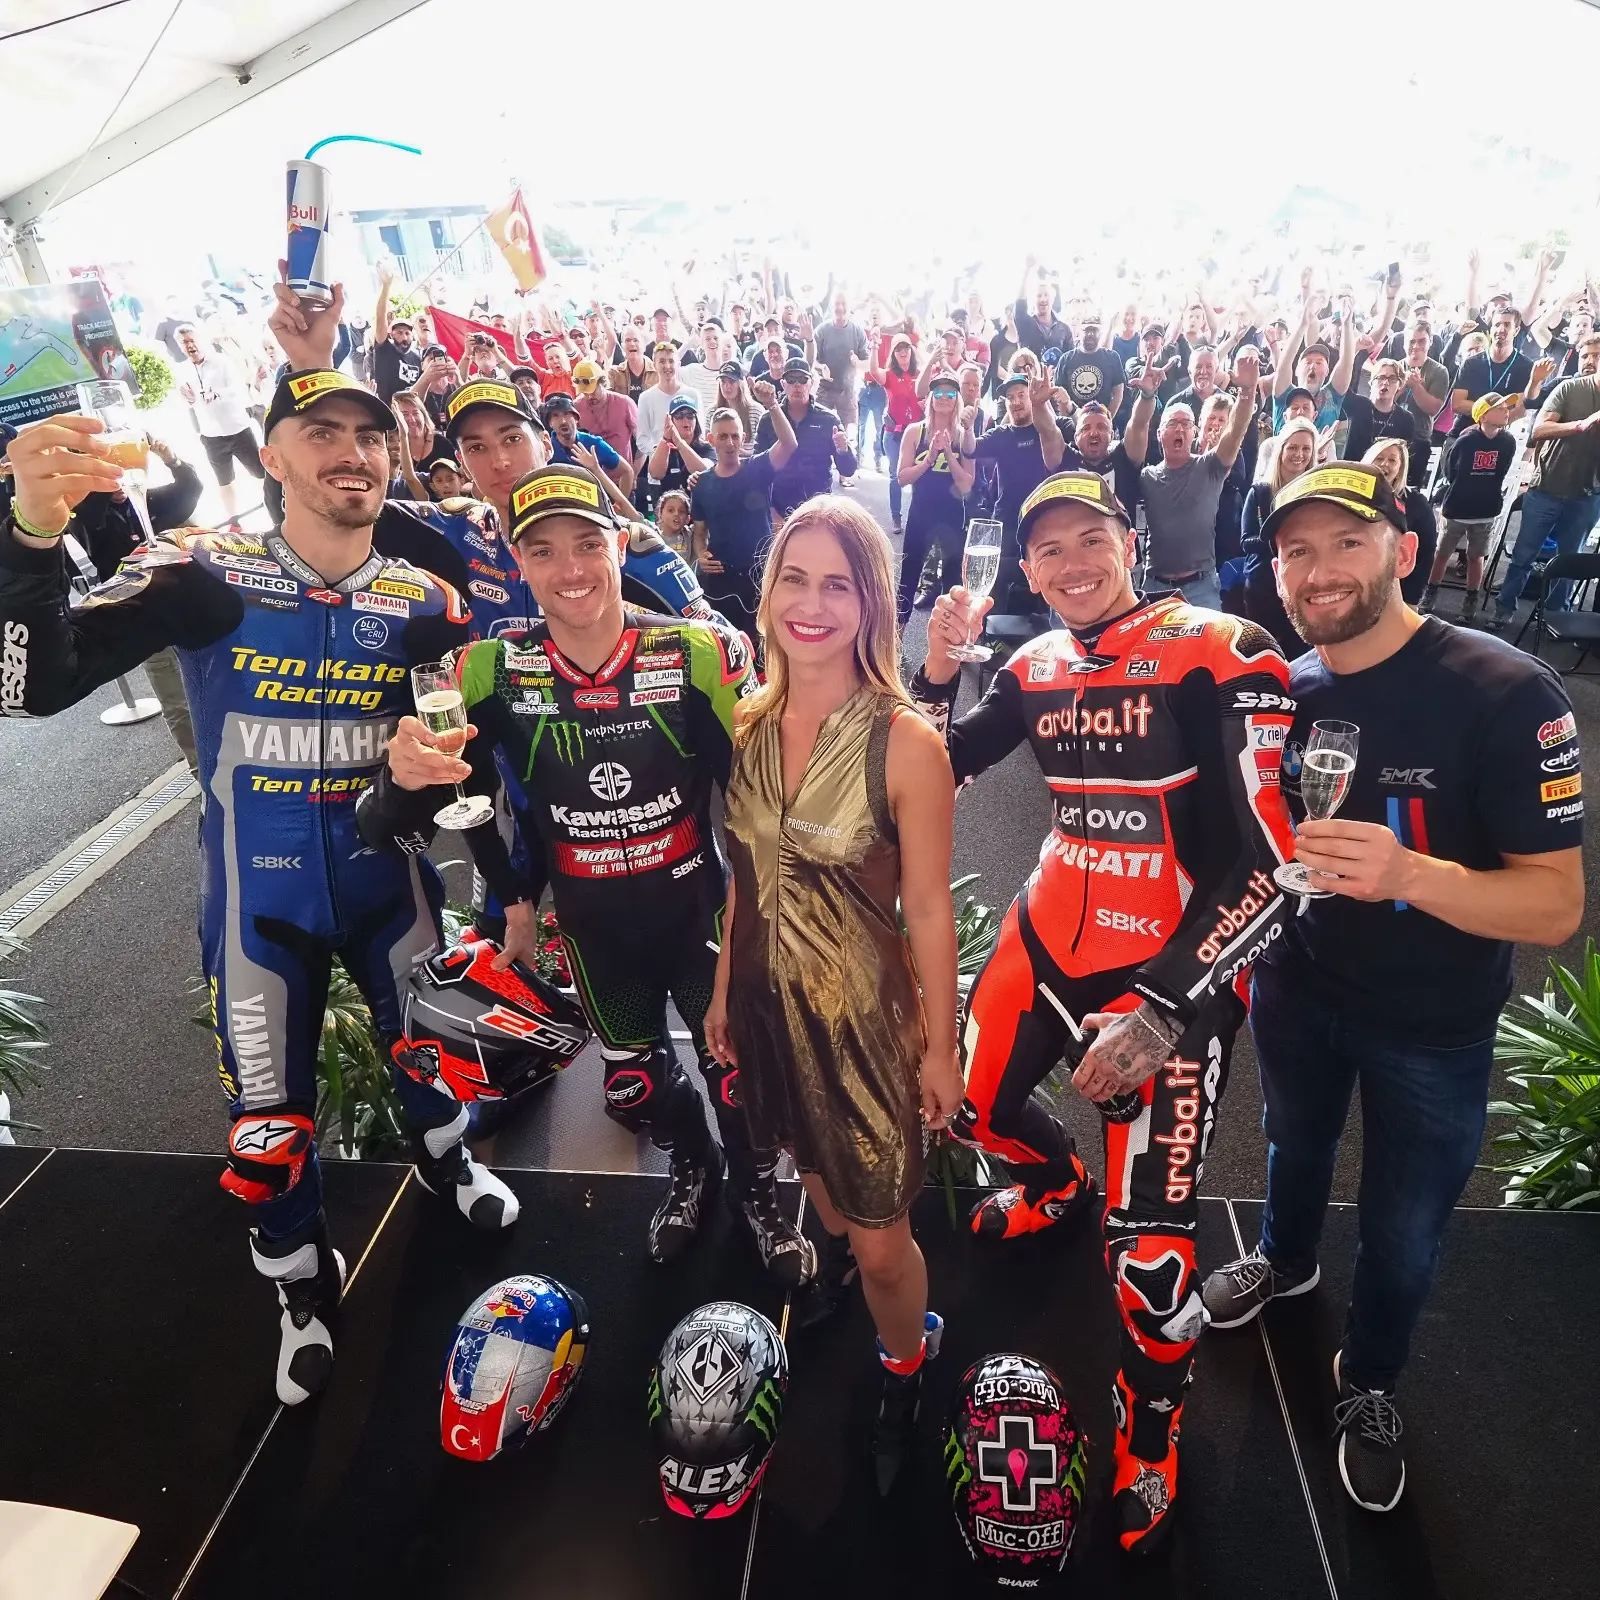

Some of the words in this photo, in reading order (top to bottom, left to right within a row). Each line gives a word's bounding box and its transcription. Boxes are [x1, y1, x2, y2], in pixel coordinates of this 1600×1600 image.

[288, 204, 318, 222] Bull
[77, 322, 95, 331] TRACK
[84, 330, 113, 340] PROHIBITED
[0, 402, 20, 414] ccess
[20, 399, 29, 408] to
[29, 397, 41, 406] the
[41, 392, 58, 403] track
[59, 390, 66, 399] is
[451, 385, 512, 414] PIRELLI
[518, 480, 593, 507] PIRELLI
[241, 574, 296, 592] ENEOS
[346, 565, 378, 590] YAMAHA
[475, 584, 504, 600] SHOEI
[260, 597, 300, 608] DELCOURT
[367, 595, 408, 611] YAMAHA
[231, 647, 307, 675] Ten
[316, 659, 406, 683] Kate
[507, 654, 549, 666] Swinton
[1128, 660, 1157, 672] FAI
[254, 680, 383, 711] Racing
[633, 689, 677, 704] SHOWA
[513, 703, 559, 713] SHARK
[1037, 694, 1153, 738] aruba.it
[585, 720, 652, 738] MONSTER
[596, 732, 644, 744] ENERGY
[238, 720, 389, 763] YAMAHA
[251, 775, 303, 793] Ten
[550, 786, 682, 827] Kawasaki
[568, 826, 628, 840] Racing
[628, 815, 672, 834] Team
[787, 817, 823, 835] PROSECCO
[824, 827, 842, 839] DOC
[252, 856, 299, 869] SBK
[591, 863, 609, 875] FUEL
[611, 861, 633, 873] YOUR
[634, 852, 664, 870] PASSION
[1096, 908, 1158, 938] SBK
[1196, 870, 1276, 964] aruba.it
[607, 1081, 644, 1100] RST
[1155, 1054, 1200, 1203] aruba.it
[660, 1454, 750, 1494] ALEX
[979, 1521, 1061, 1546] Muc-Off
[998, 1576, 1039, 1588] SHARK
